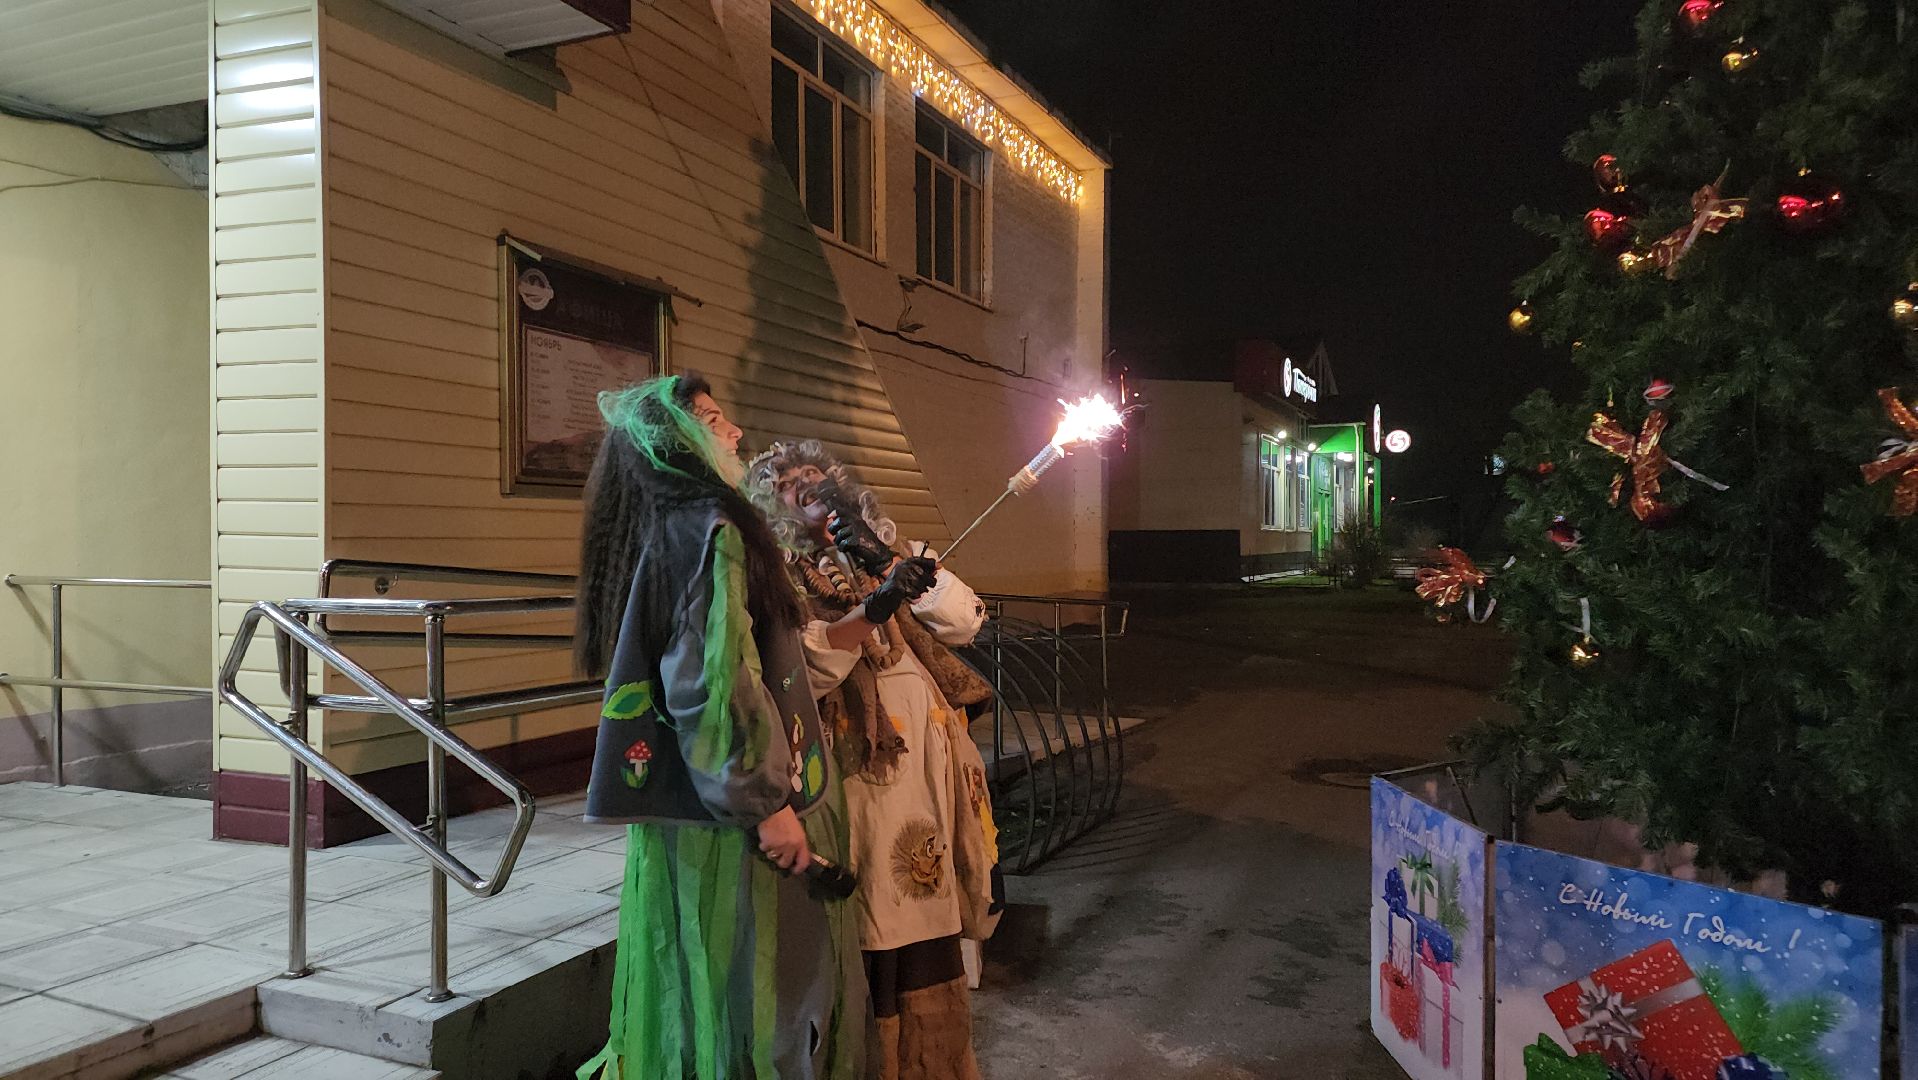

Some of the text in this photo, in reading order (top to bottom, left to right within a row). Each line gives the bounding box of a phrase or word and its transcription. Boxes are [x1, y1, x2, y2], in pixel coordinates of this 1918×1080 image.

[530, 335, 562, 351] НОЯБРЬ
[1559, 883, 1802, 952] С Новым Годом !
